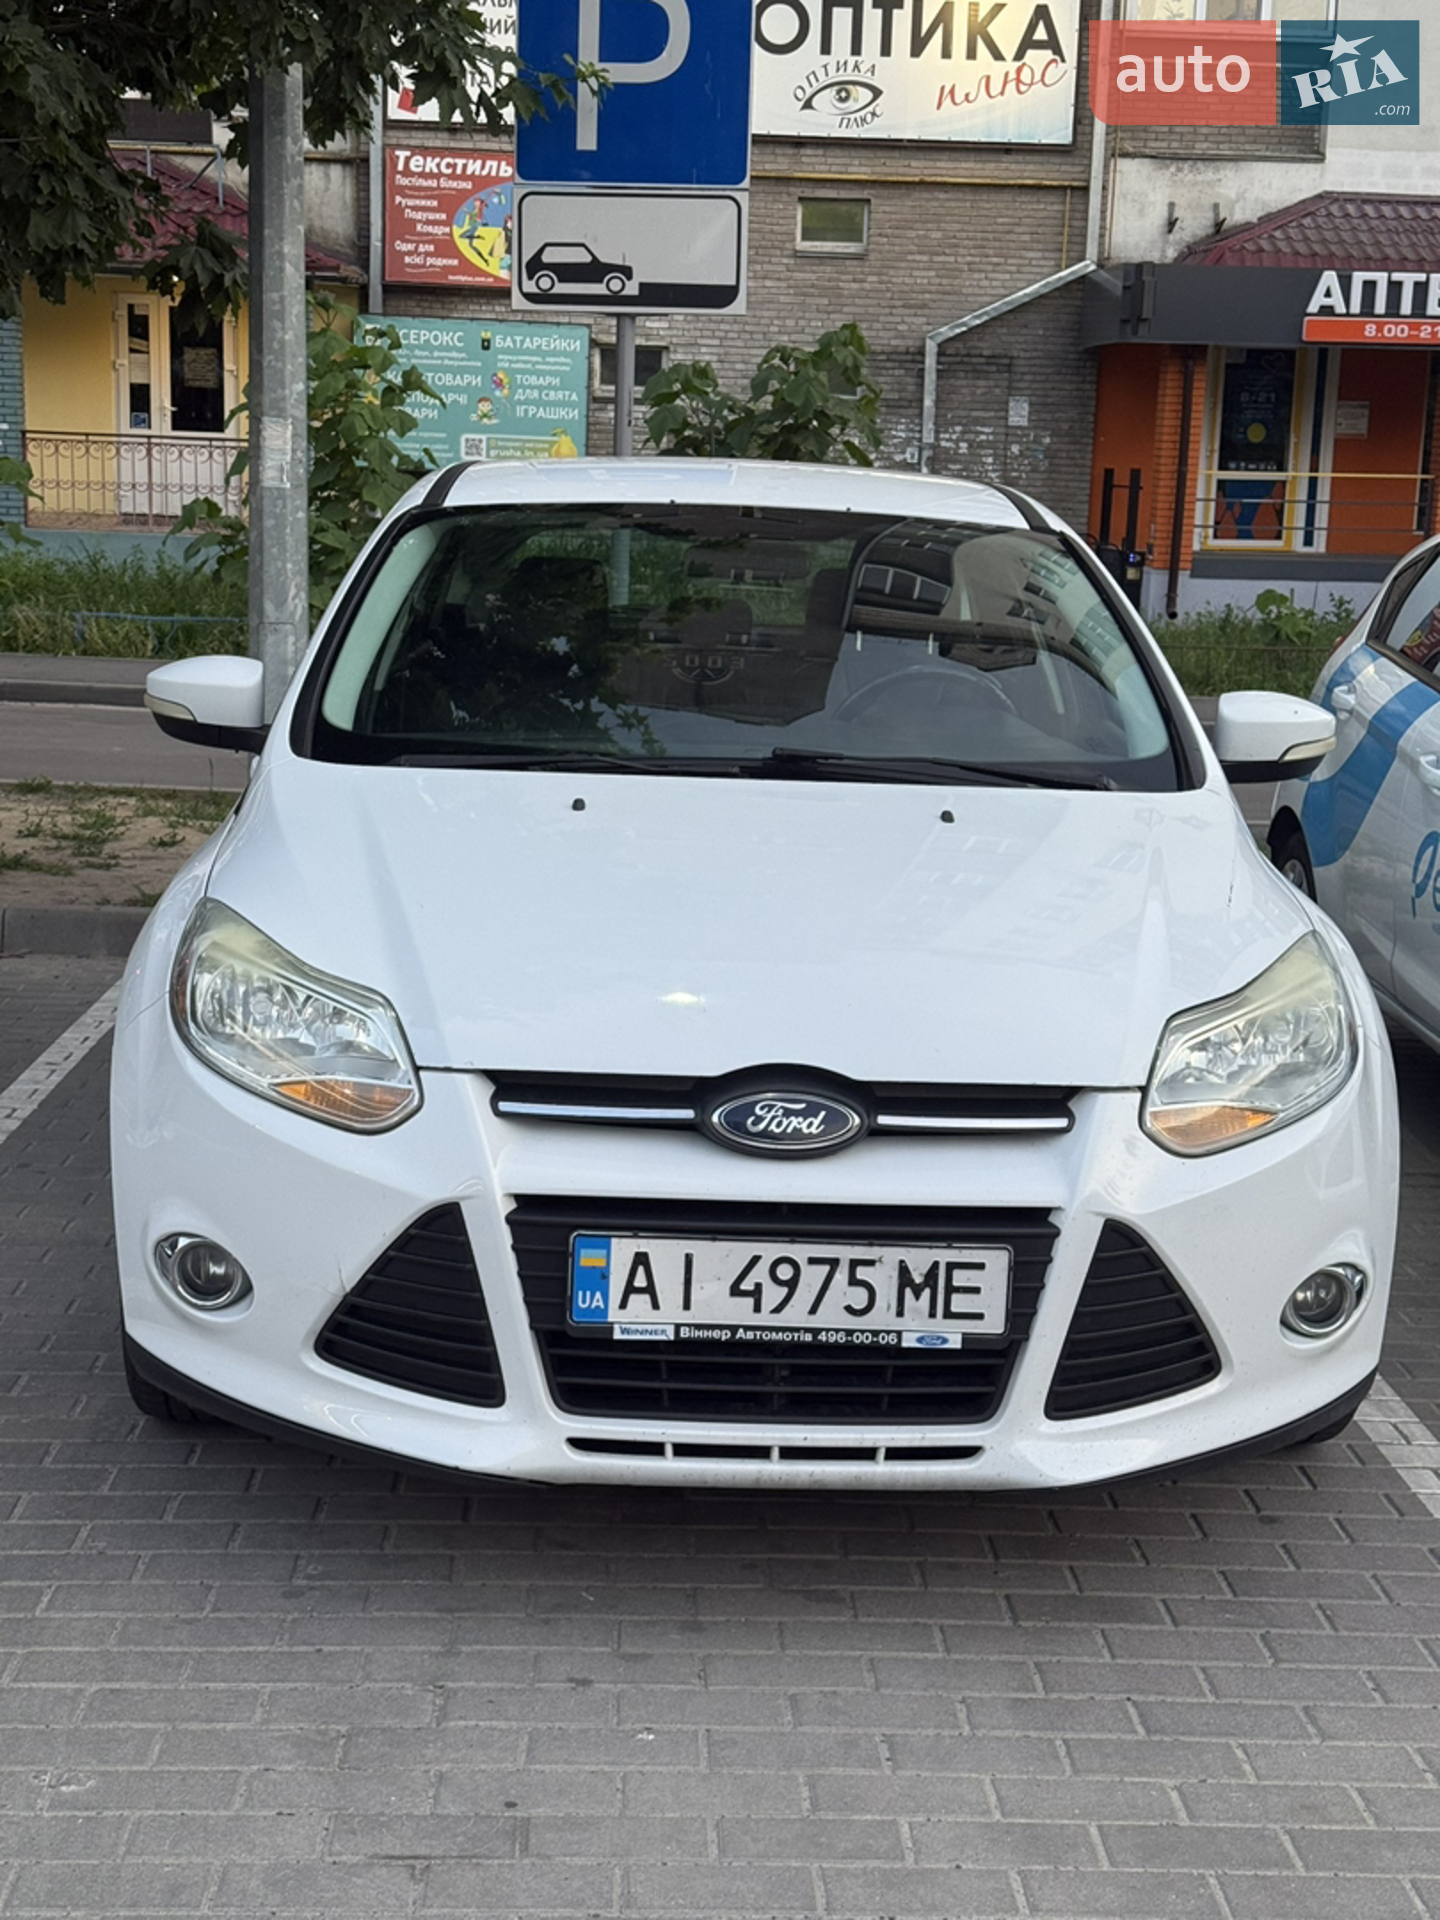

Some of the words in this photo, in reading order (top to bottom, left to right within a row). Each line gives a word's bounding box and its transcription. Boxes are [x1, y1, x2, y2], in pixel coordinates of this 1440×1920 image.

[755, 0, 1066, 63] ОПТИКА
[792, 59, 877, 102] ОПТИКА
[837, 103, 884, 130] ПЛЮС
[394, 150, 514, 178] Текстиль
[395, 174, 438, 189] Постільна
[439, 177, 473, 190] білизна
[394, 195, 438, 208] Рушники
[404, 208, 447, 222] Подушки
[416, 222, 450, 235] Ковдри
[417, 243, 435, 253] для
[395, 328, 465, 347] СЕРОКС
[494, 333, 581, 352] БАТАРЕЙКИ
[515, 374, 560, 387] ТОВАРИ
[513, 388, 540, 402] ДЛЯ
[541, 390, 579, 403] СВЯТА
[516, 405, 579, 420] ІГРАШКИ
[746, 1101, 825, 1136] Ford
[618, 1250, 694, 1312] AI
[729, 1254, 877, 1318] 4975
[896, 1258, 986, 1321] ME
[577, 1290, 605, 1310] UA
[679, 1325, 731, 1341] Віннер
[735, 1328, 813, 1344] Автомотів
[817, 1330, 898, 1345] 496-00-06
